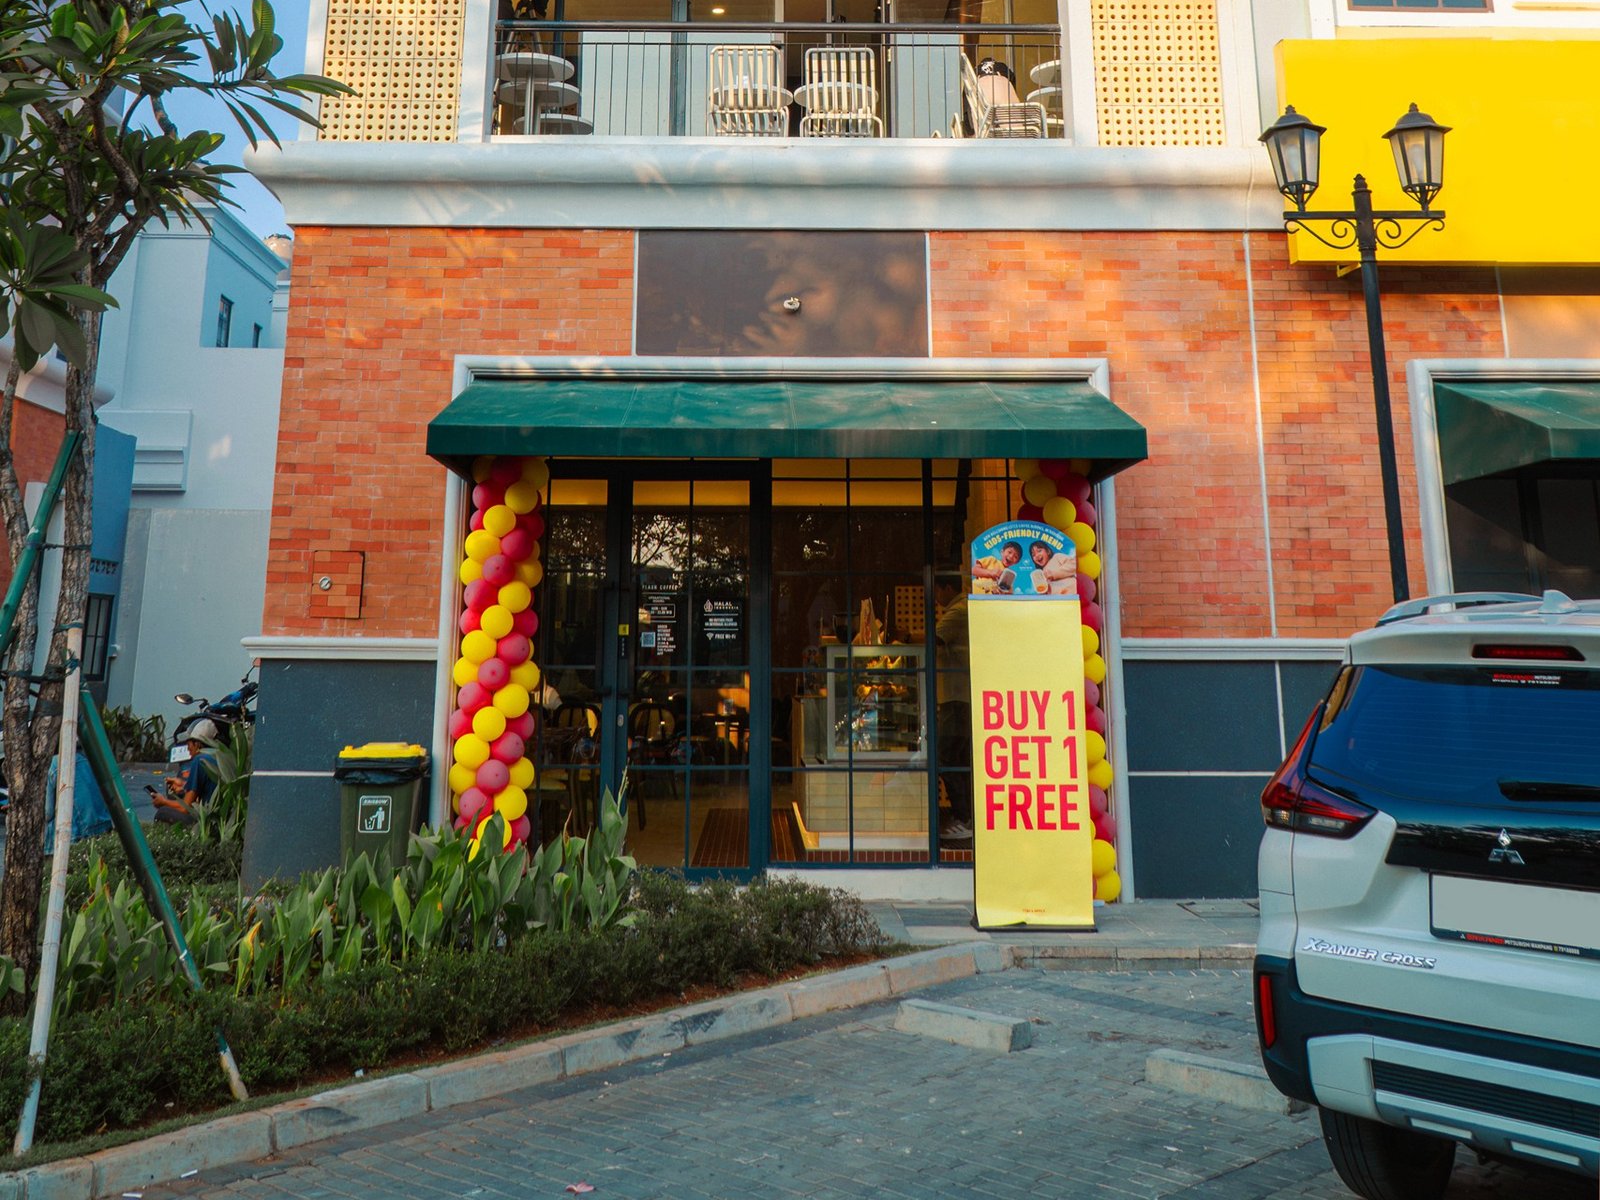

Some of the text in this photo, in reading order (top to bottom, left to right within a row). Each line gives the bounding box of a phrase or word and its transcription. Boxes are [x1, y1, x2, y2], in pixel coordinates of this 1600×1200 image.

[984, 530, 1040, 550] KIDS-FRIENDLY
[1041, 533, 1064, 550] MENU
[982, 690, 1076, 731] BUY 1
[984, 735, 1078, 779] GET 1
[985, 784, 1080, 830] FREE
[1302, 937, 1437, 969] XPANDER CROSS
